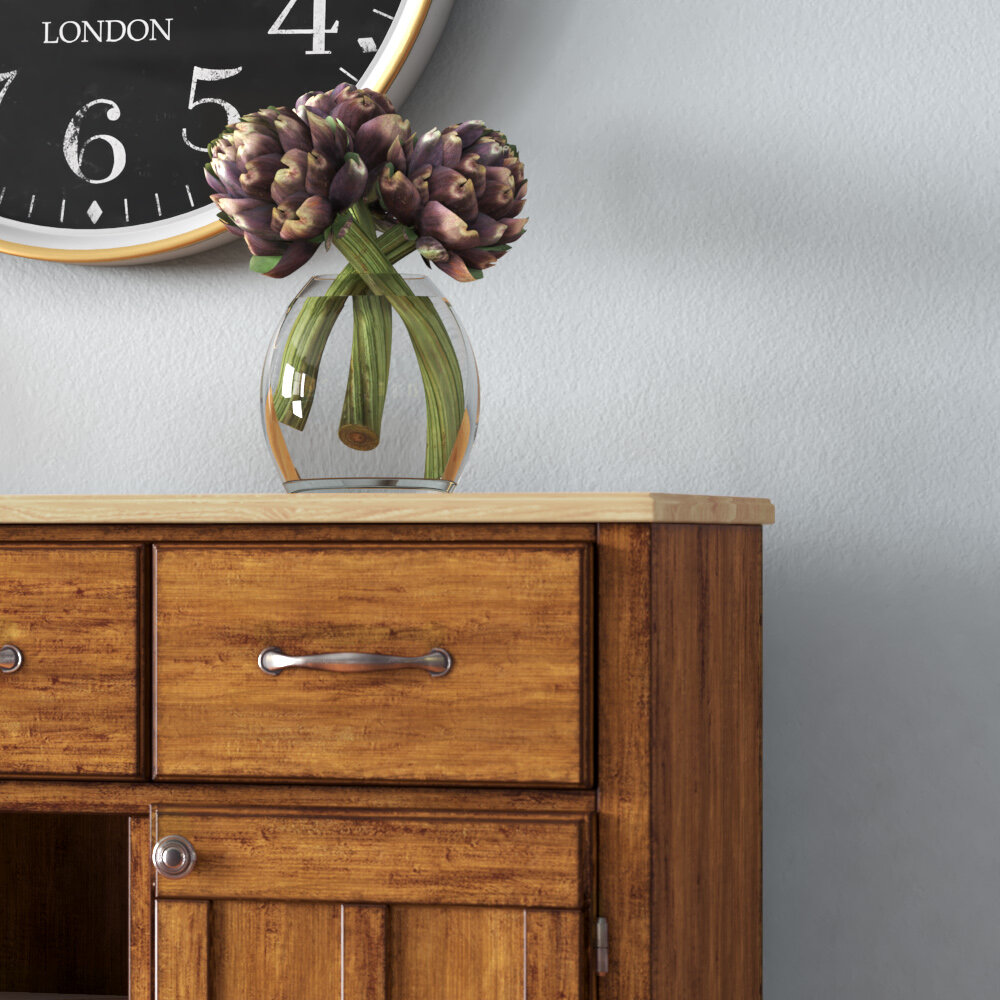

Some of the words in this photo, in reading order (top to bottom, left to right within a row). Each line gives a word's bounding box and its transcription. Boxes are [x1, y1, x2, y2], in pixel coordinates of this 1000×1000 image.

[42, 18, 174, 44] LONDON
[62, 98, 127, 184] 6
[182, 65, 243, 153] 5
